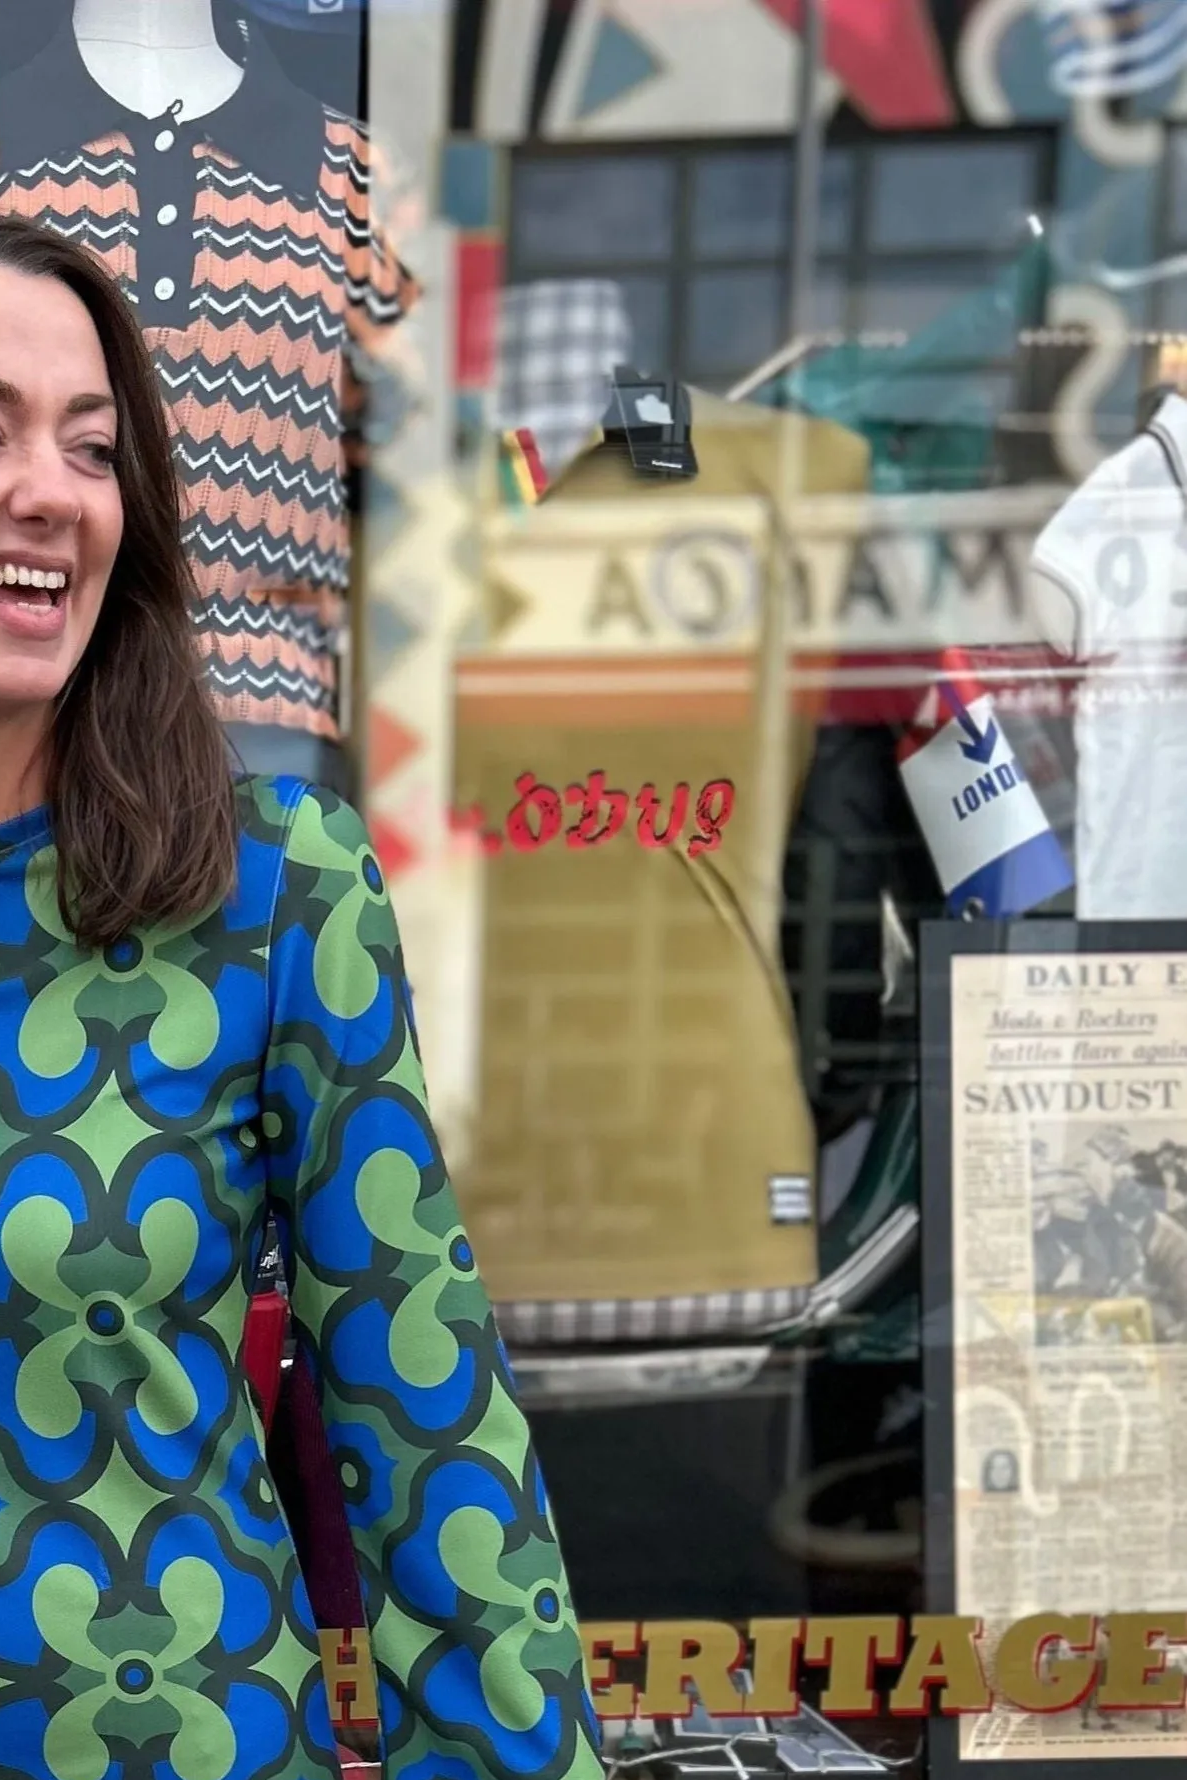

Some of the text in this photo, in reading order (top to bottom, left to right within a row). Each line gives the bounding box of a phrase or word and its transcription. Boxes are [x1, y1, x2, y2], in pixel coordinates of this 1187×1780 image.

[1027, 963, 1139, 987] DAILY
[989, 1009, 1043, 1030] Mods
[1076, 1007, 1159, 1030] Rockers
[991, 1042, 1062, 1062] battles
[1072, 1040, 1125, 1062] flare
[964, 1079, 1181, 1115] SAWDUST
